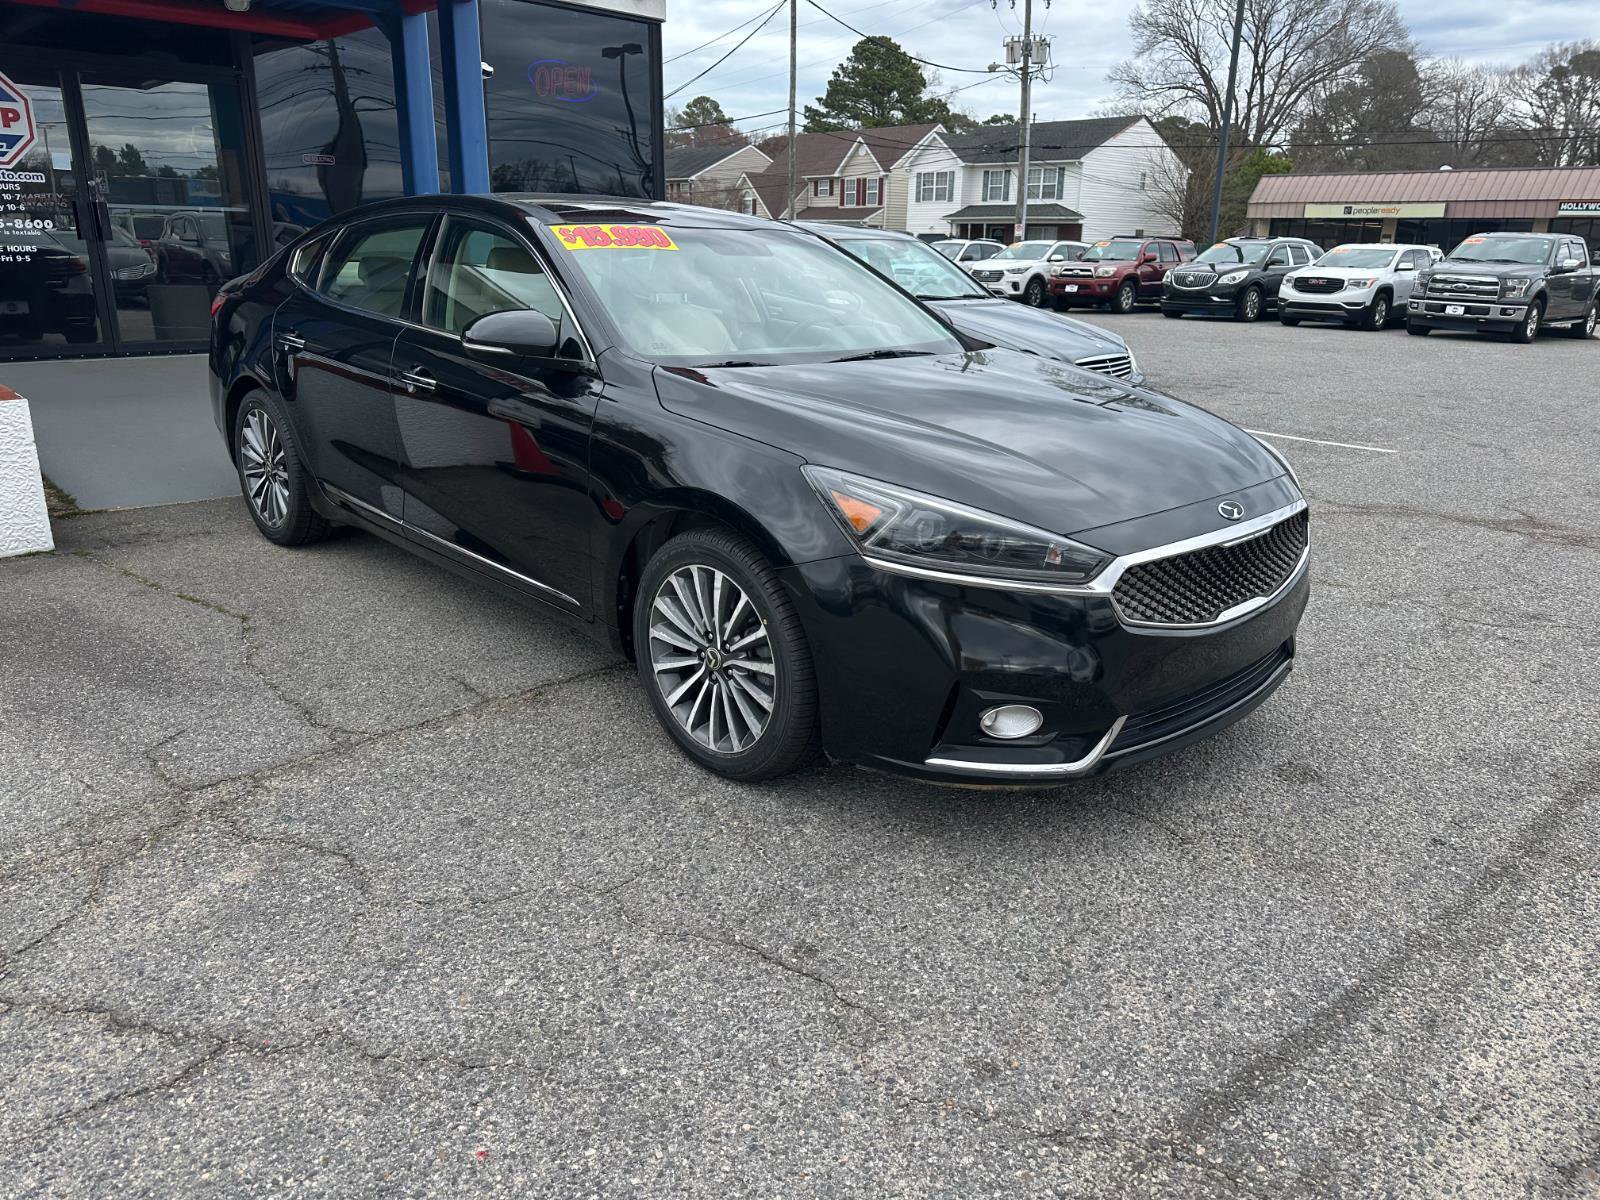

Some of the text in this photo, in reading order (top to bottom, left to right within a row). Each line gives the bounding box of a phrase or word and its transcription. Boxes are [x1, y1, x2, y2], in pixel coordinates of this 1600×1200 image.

[535, 66, 592, 97] OPEN
[0, 171, 43, 181] to.com
[2, 193, 21, 201] 10-7
[6, 203, 25, 211] 10-6
[1352, 207, 1401, 216] peopleready
[16, 254, 31, 262] 9-5
